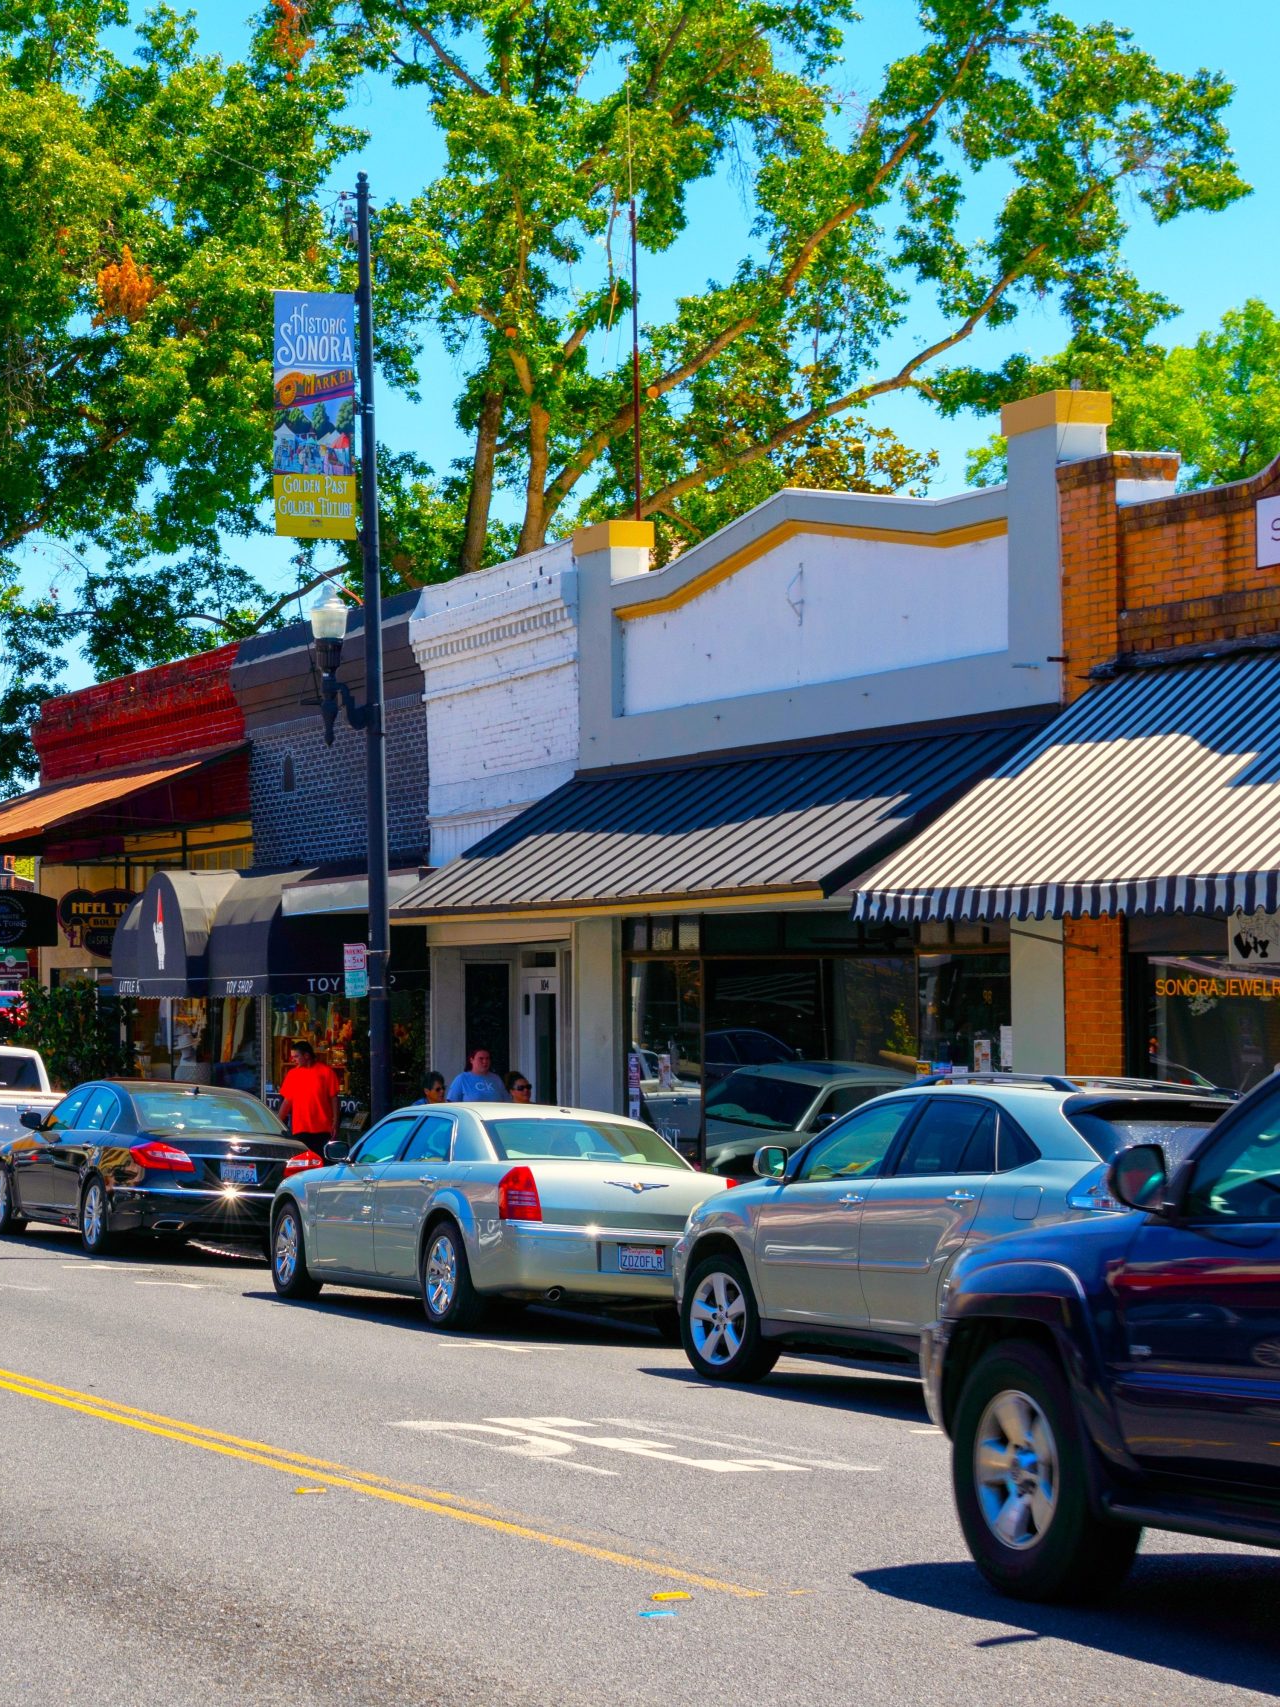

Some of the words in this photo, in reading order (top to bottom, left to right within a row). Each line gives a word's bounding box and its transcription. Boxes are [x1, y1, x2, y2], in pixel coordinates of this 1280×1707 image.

[277, 322, 353, 366] SONORA
[71, 902, 109, 914] HEEL
[119, 980, 136, 993] LITTLE
[226, 981, 236, 993] TOY
[237, 979, 253, 993] SHOP
[307, 977, 340, 992] TOY
[1155, 978, 1219, 996] SONORA
[475, 1082, 495, 1091] CK
